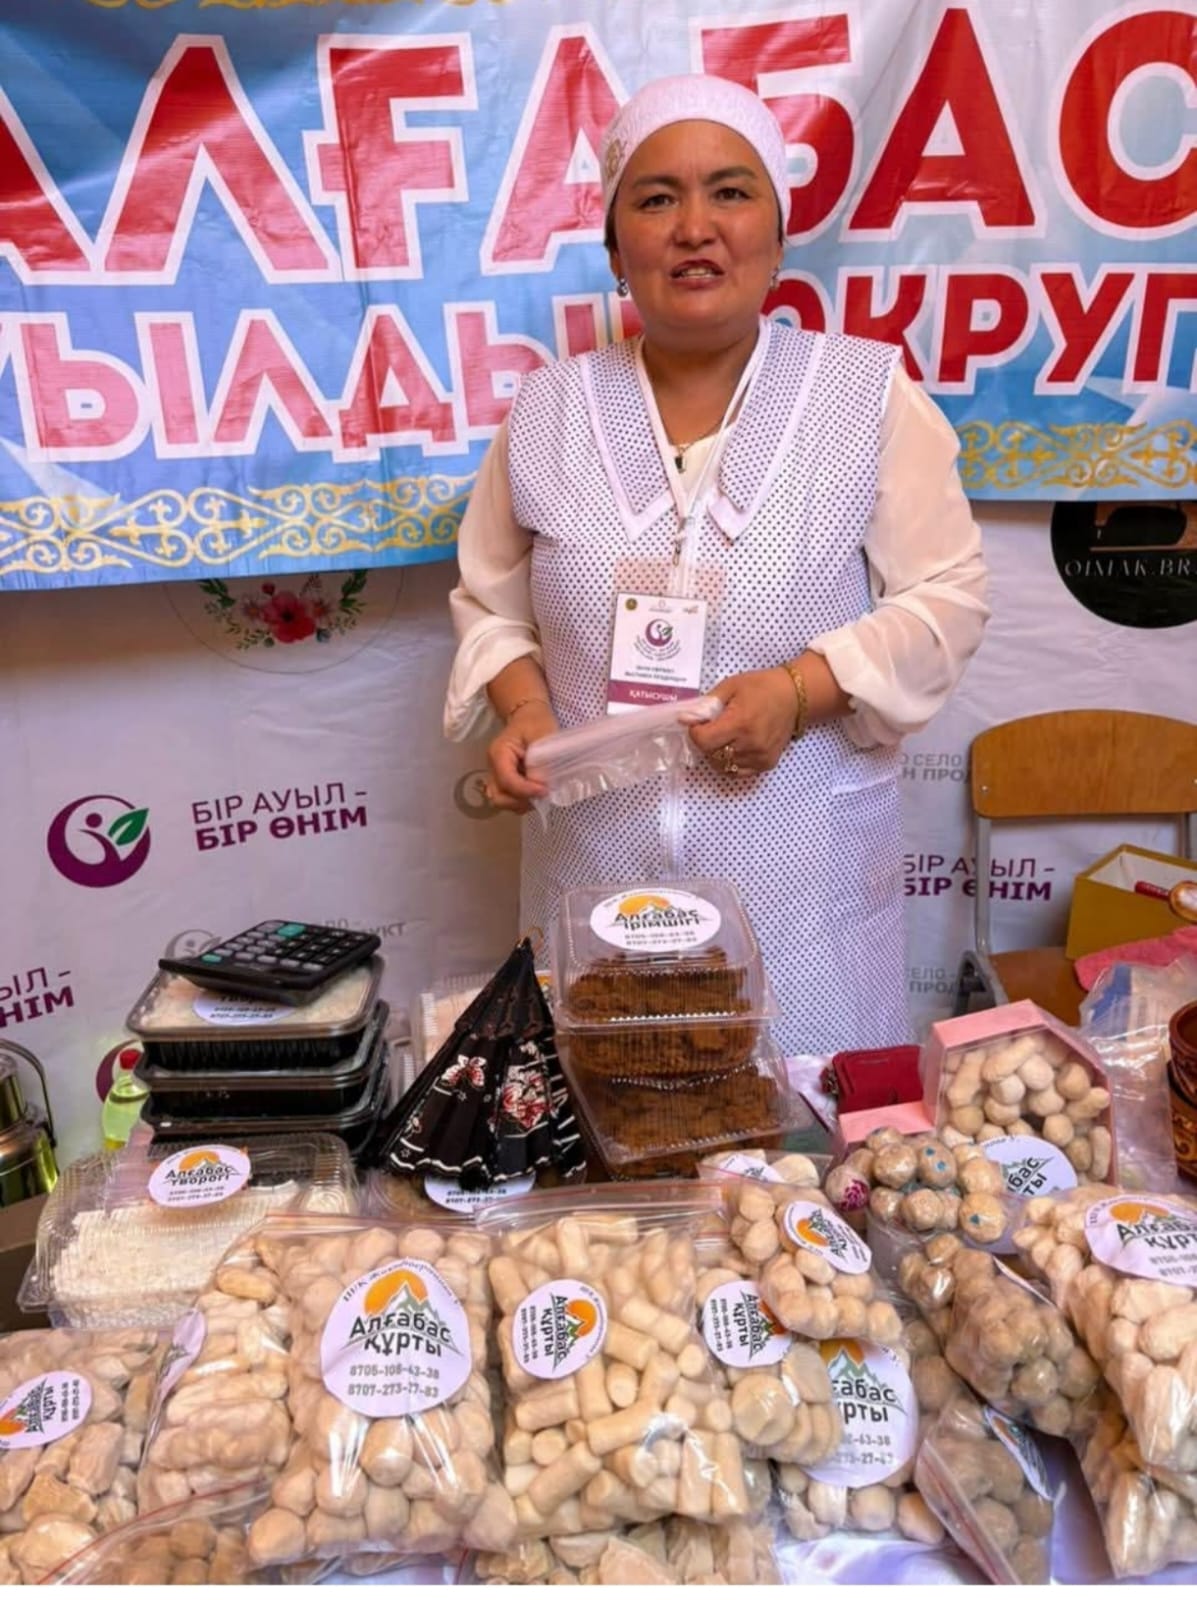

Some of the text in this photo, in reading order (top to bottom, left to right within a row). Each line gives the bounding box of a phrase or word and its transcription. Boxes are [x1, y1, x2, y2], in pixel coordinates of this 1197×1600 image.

[923, 767, 970, 785] ПРО
[191, 795, 243, 825] БІР
[252, 782, 346, 815] АУЫЛ
[195, 806, 367, 851] БІР ӨНІМ
[0, 985, 74, 1028] НІМ
[349, 1311, 451, 1344] Алғабас
[838, 1400, 889, 1425] рты
